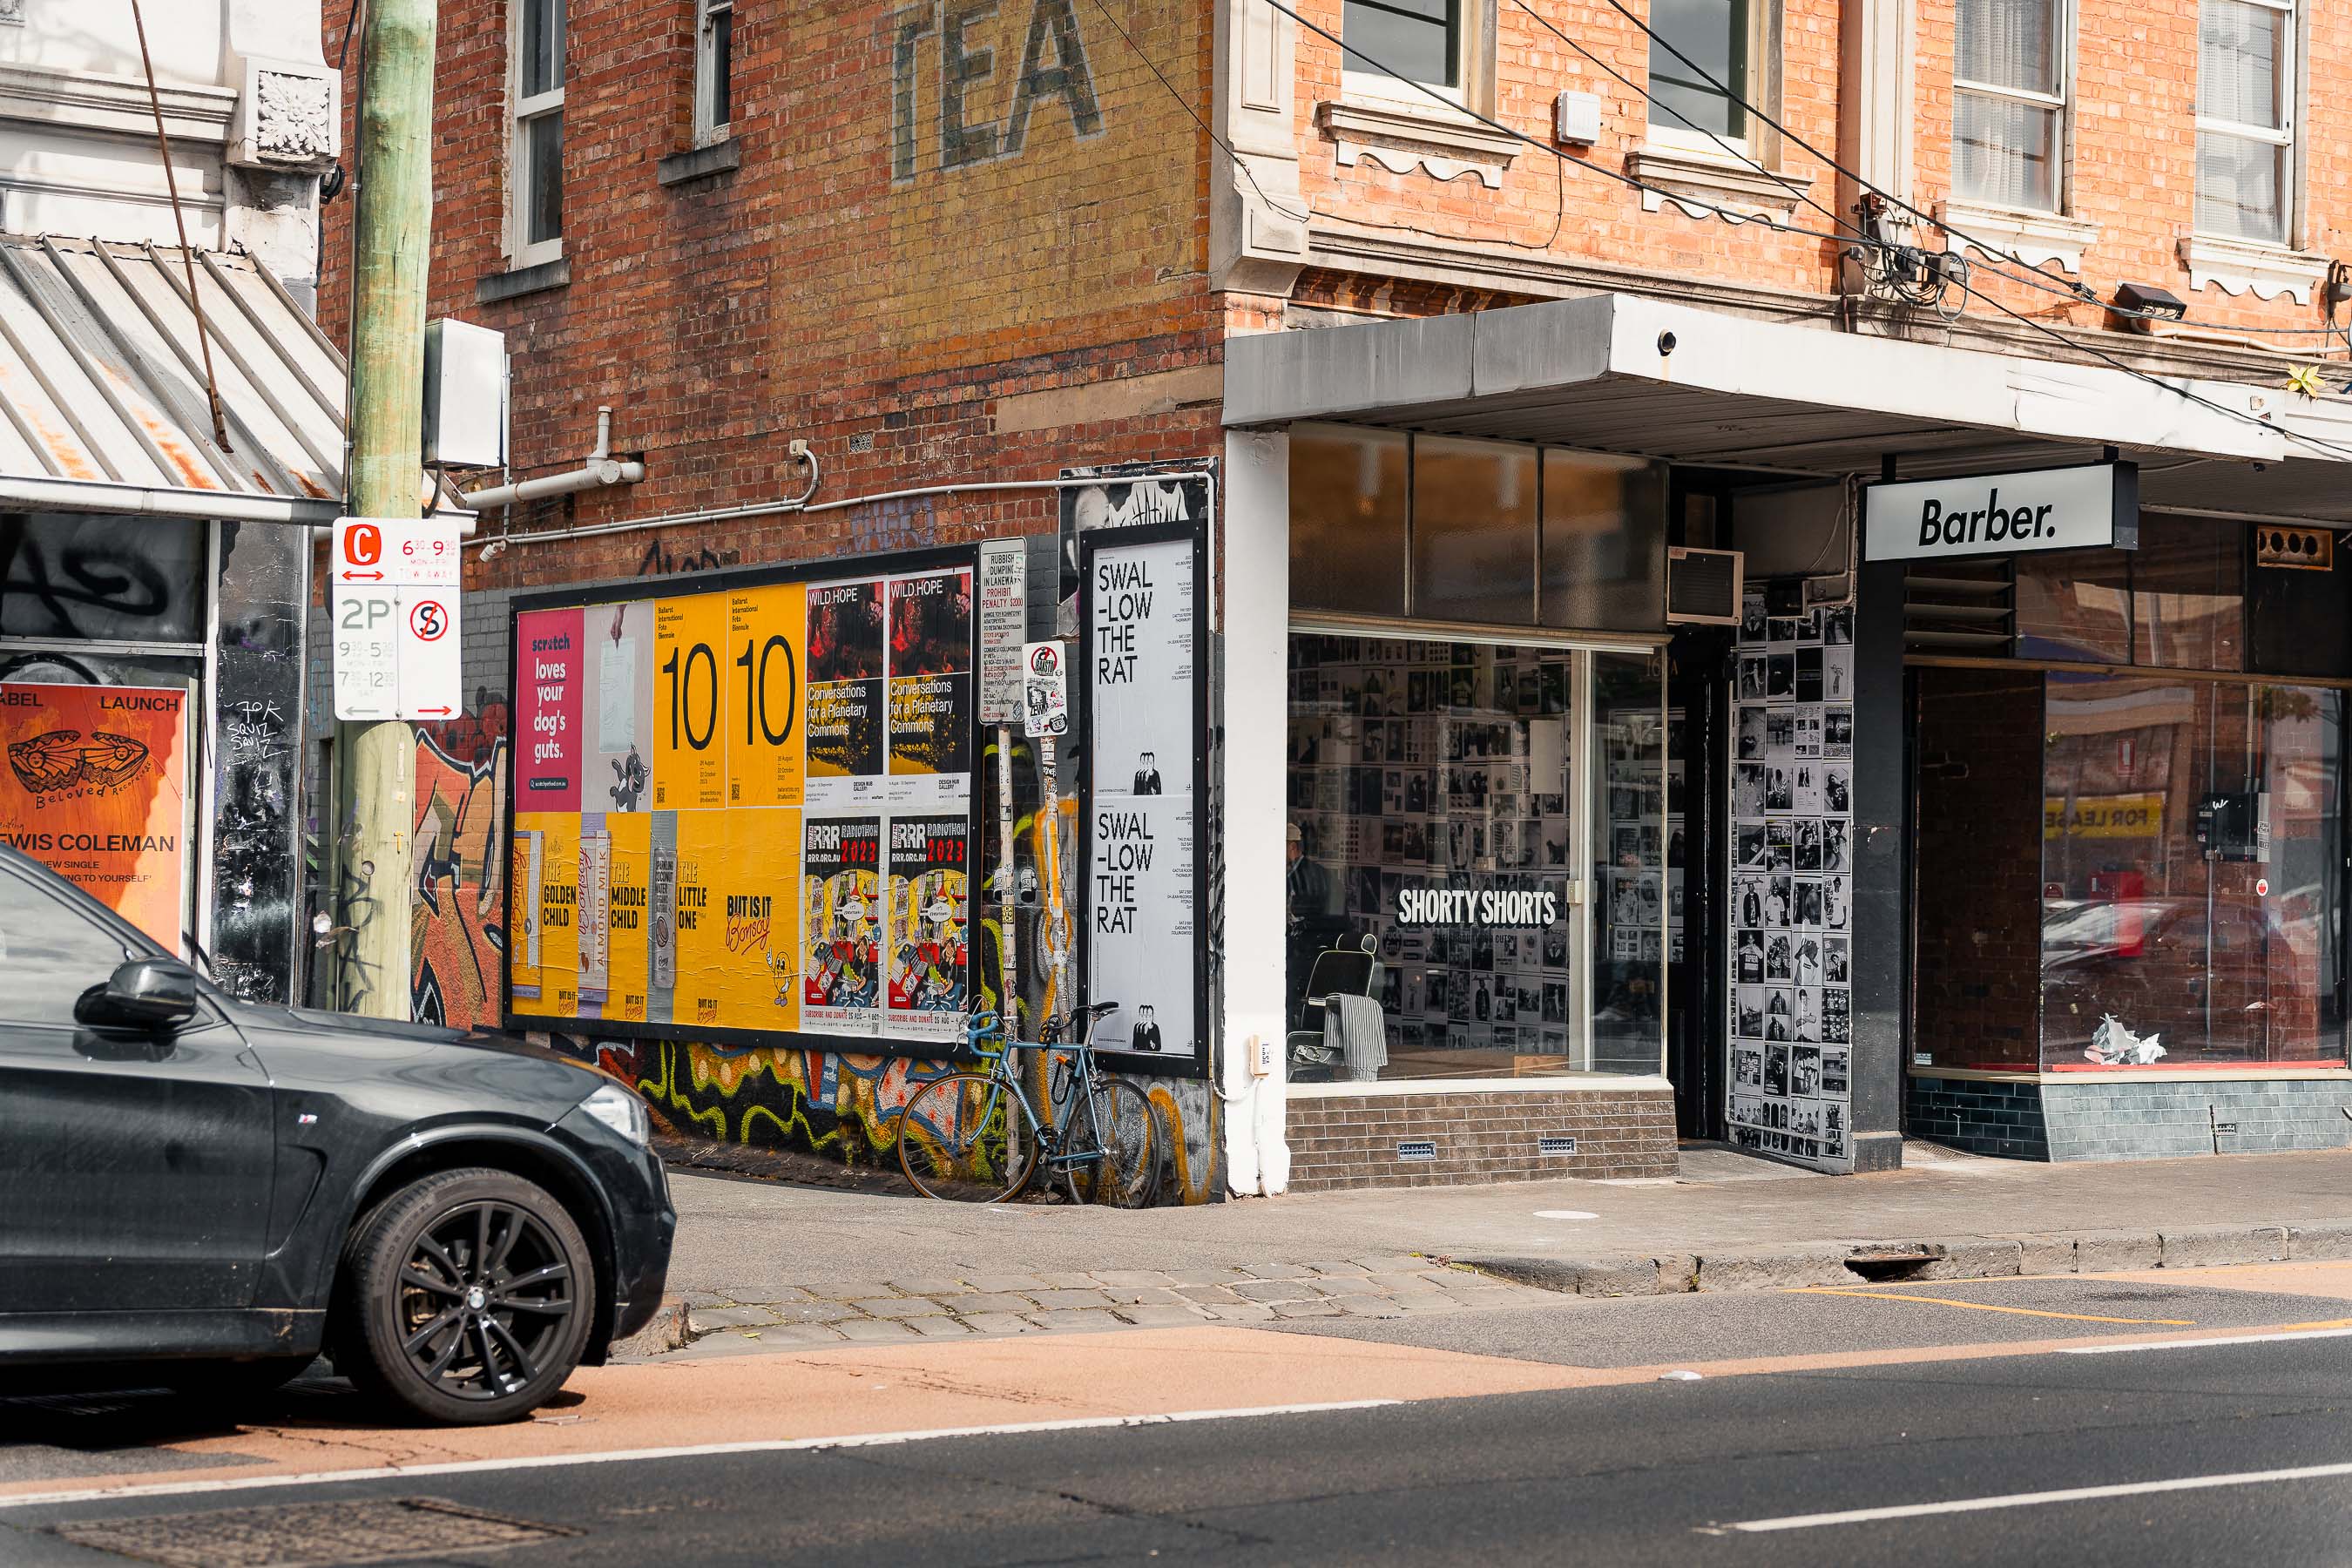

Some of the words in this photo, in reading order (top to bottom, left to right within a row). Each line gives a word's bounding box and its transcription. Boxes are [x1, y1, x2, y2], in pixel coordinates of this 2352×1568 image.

[875, 0, 1107, 186] TEA
[1918, 488, 2055, 546] Barber.
[990, 554, 1014, 564] RUBBISH
[984, 577, 990, 586] IN
[1099, 561, 1152, 591] SWAL
[983, 598, 1007, 608] PENALTY
[1010, 598, 1023, 607] $2000
[1098, 591, 1152, 621] -LOW
[341, 598, 389, 629] 2P
[1098, 625, 1135, 653] THE
[536, 658, 565, 679] loves
[1098, 656, 1138, 685] RAT
[537, 686, 564, 709] your
[663, 643, 717, 750] 10
[737, 635, 795, 746] 10
[808, 685, 866, 701] Conversations
[890, 681, 952, 697] Conversations
[100, 696, 179, 712] LAUNCH
[808, 706, 819, 719] for
[820, 708, 826, 718] a
[828, 704, 867, 721] Planetary
[890, 702, 902, 715] for
[903, 705, 909, 714] a
[912, 700, 953, 716] Planetary
[534, 708, 566, 736] dog's
[808, 723, 849, 738] Commons
[890, 720, 934, 733] Commons
[534, 741, 564, 765] guts.
[36, 786, 105, 809] Beloved
[112, 760, 152, 795] Recordings
[841, 824, 878, 837] RADIOTHON
[927, 823, 966, 836] RADIOTHON
[1098, 813, 1153, 840] SWAL
[57, 834, 175, 853] COLEMAN
[841, 840, 876, 862] 2023
[892, 853, 927, 862] RRR.ORG.AU
[927, 839, 964, 862] 2023
[64, 861, 99, 869] SINGLE
[1098, 844, 1152, 871] -LOW
[84, 874, 97, 882] TO
[544, 862, 560, 882] THE
[612, 862, 629, 882] THE
[679, 862, 697, 882] THE
[544, 885, 576, 904] GOLDEN
[611, 887, 645, 906] MIDDLE
[679, 888, 706, 907] LITTLE
[1097, 875, 1134, 902] THE
[727, 896, 747, 916] BUT
[750, 896, 760, 917] IS
[761, 896, 772, 917] IT
[1398, 889, 1478, 924] SHORTY
[1481, 889, 1556, 925] SHORTS
[544, 908, 569, 927] CHILD
[611, 910, 638, 929] CHILD
[679, 910, 697, 929] ONE
[1098, 906, 1137, 934] RAT
[598, 898, 606, 966] ALMOND
[726, 913, 770, 956] Bonsoy
[639, 995, 644, 1004] IT
[698, 998, 706, 1008] BUT
[707, 999, 711, 1008] IS
[712, 999, 718, 1009] IT
